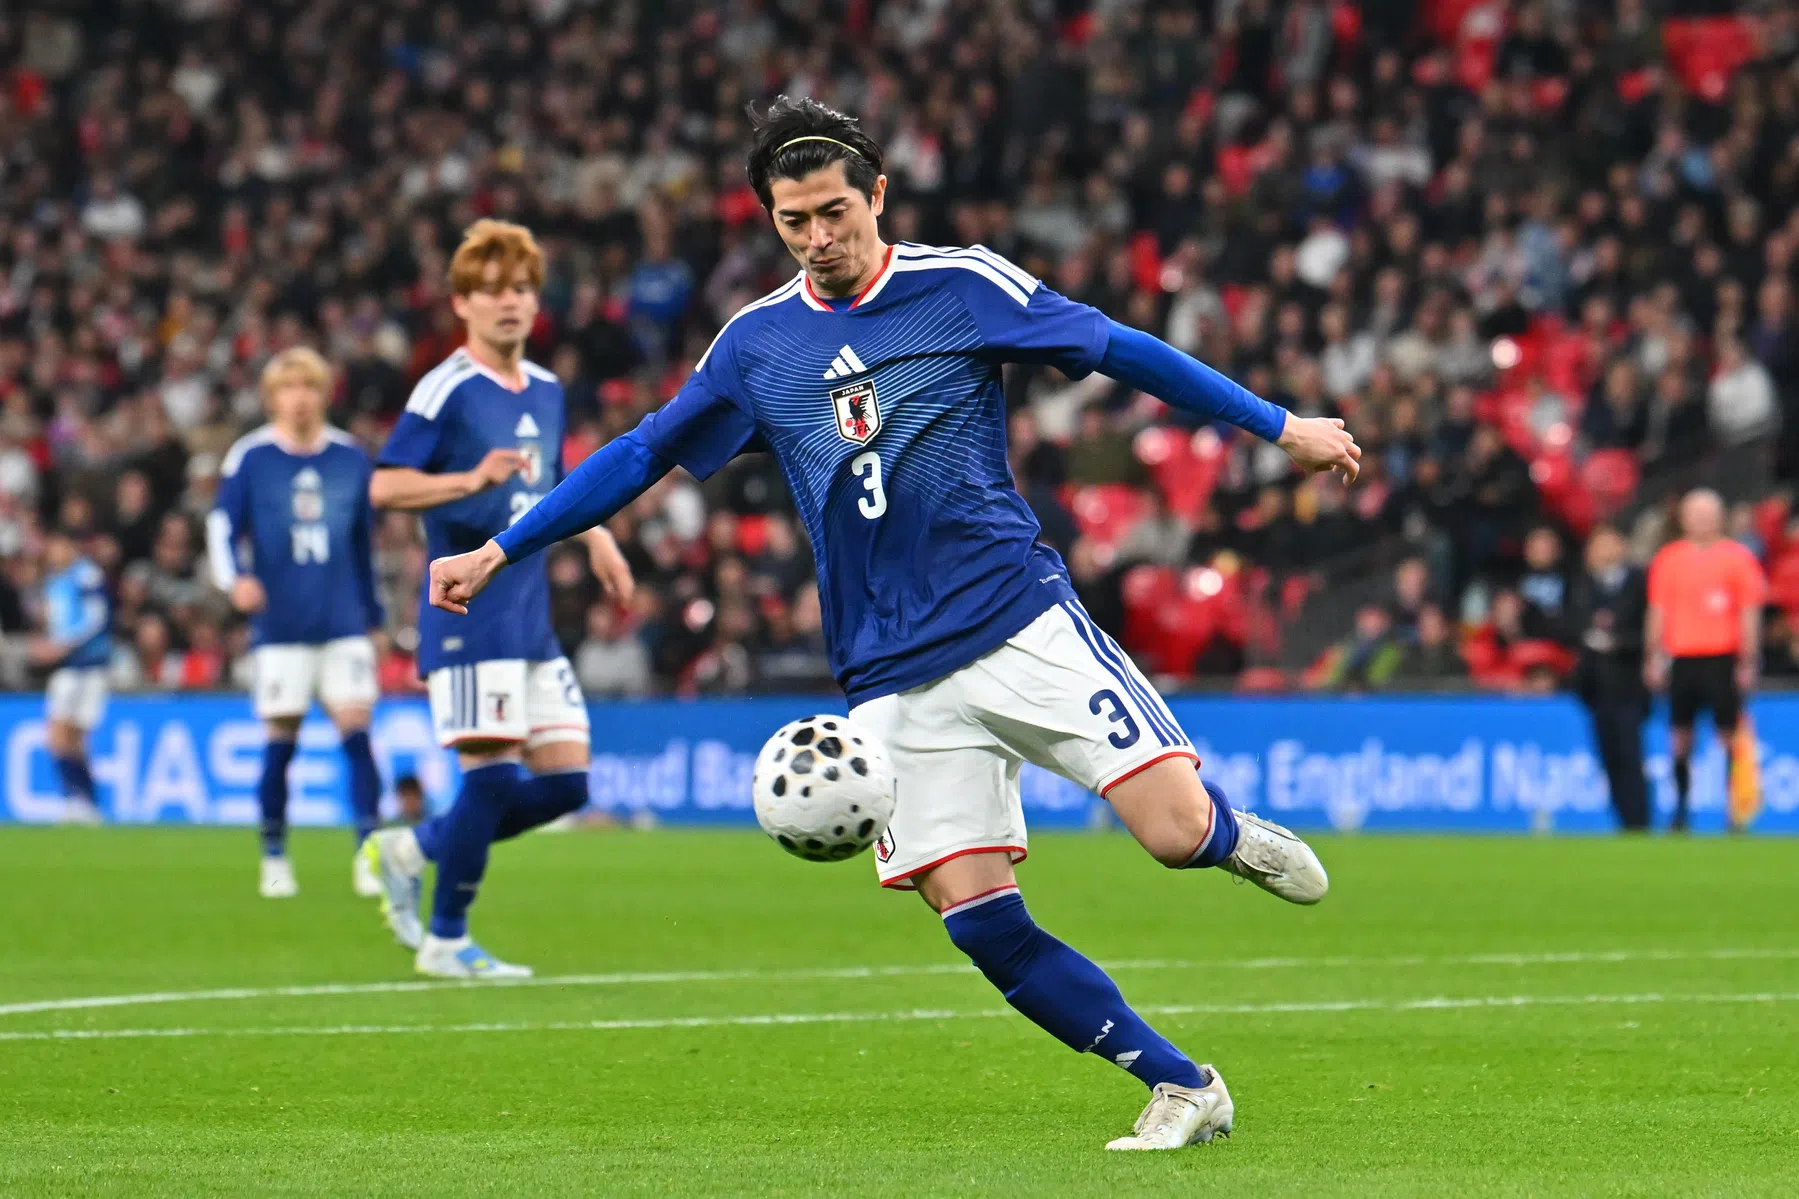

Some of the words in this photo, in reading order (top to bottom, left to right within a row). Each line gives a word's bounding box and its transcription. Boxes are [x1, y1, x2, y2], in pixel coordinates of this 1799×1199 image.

[841, 385, 865, 396] JAPAN
[852, 424, 871, 436] JFA
[851, 451, 888, 520] 3
[289, 523, 331, 567] 14
[1088, 688, 1141, 750] 3
[5, 717, 341, 824] CHASE
[1267, 734, 1484, 815] England
